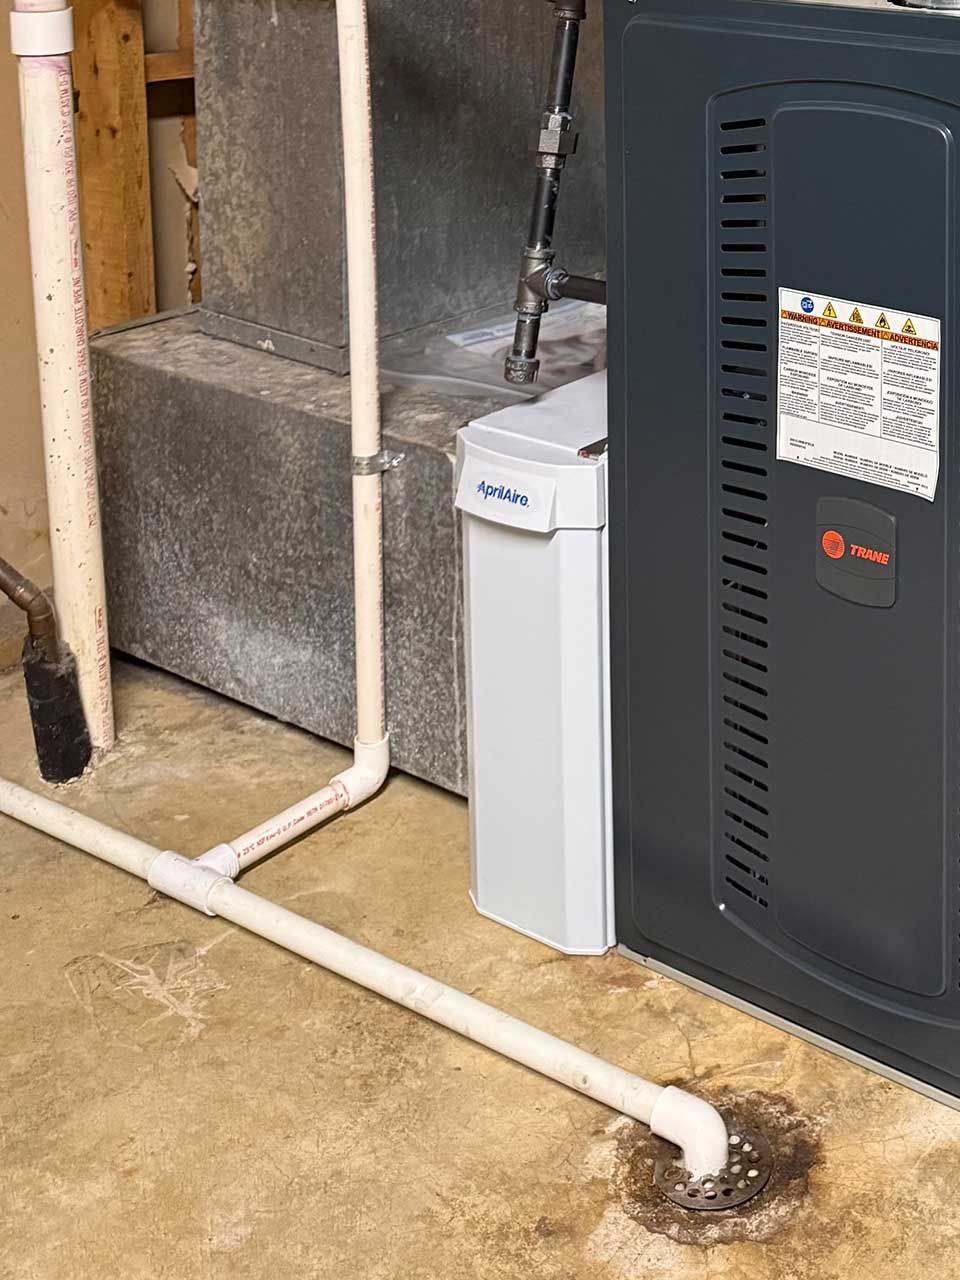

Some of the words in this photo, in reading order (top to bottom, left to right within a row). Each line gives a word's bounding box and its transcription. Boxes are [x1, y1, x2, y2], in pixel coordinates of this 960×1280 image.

[788, 311, 819, 325] WARNING
[826, 320, 881, 338] AVERTISSEMENT
[889, 333, 939, 351] ADVERTENCIA
[849, 543, 890, 566] TRANE
